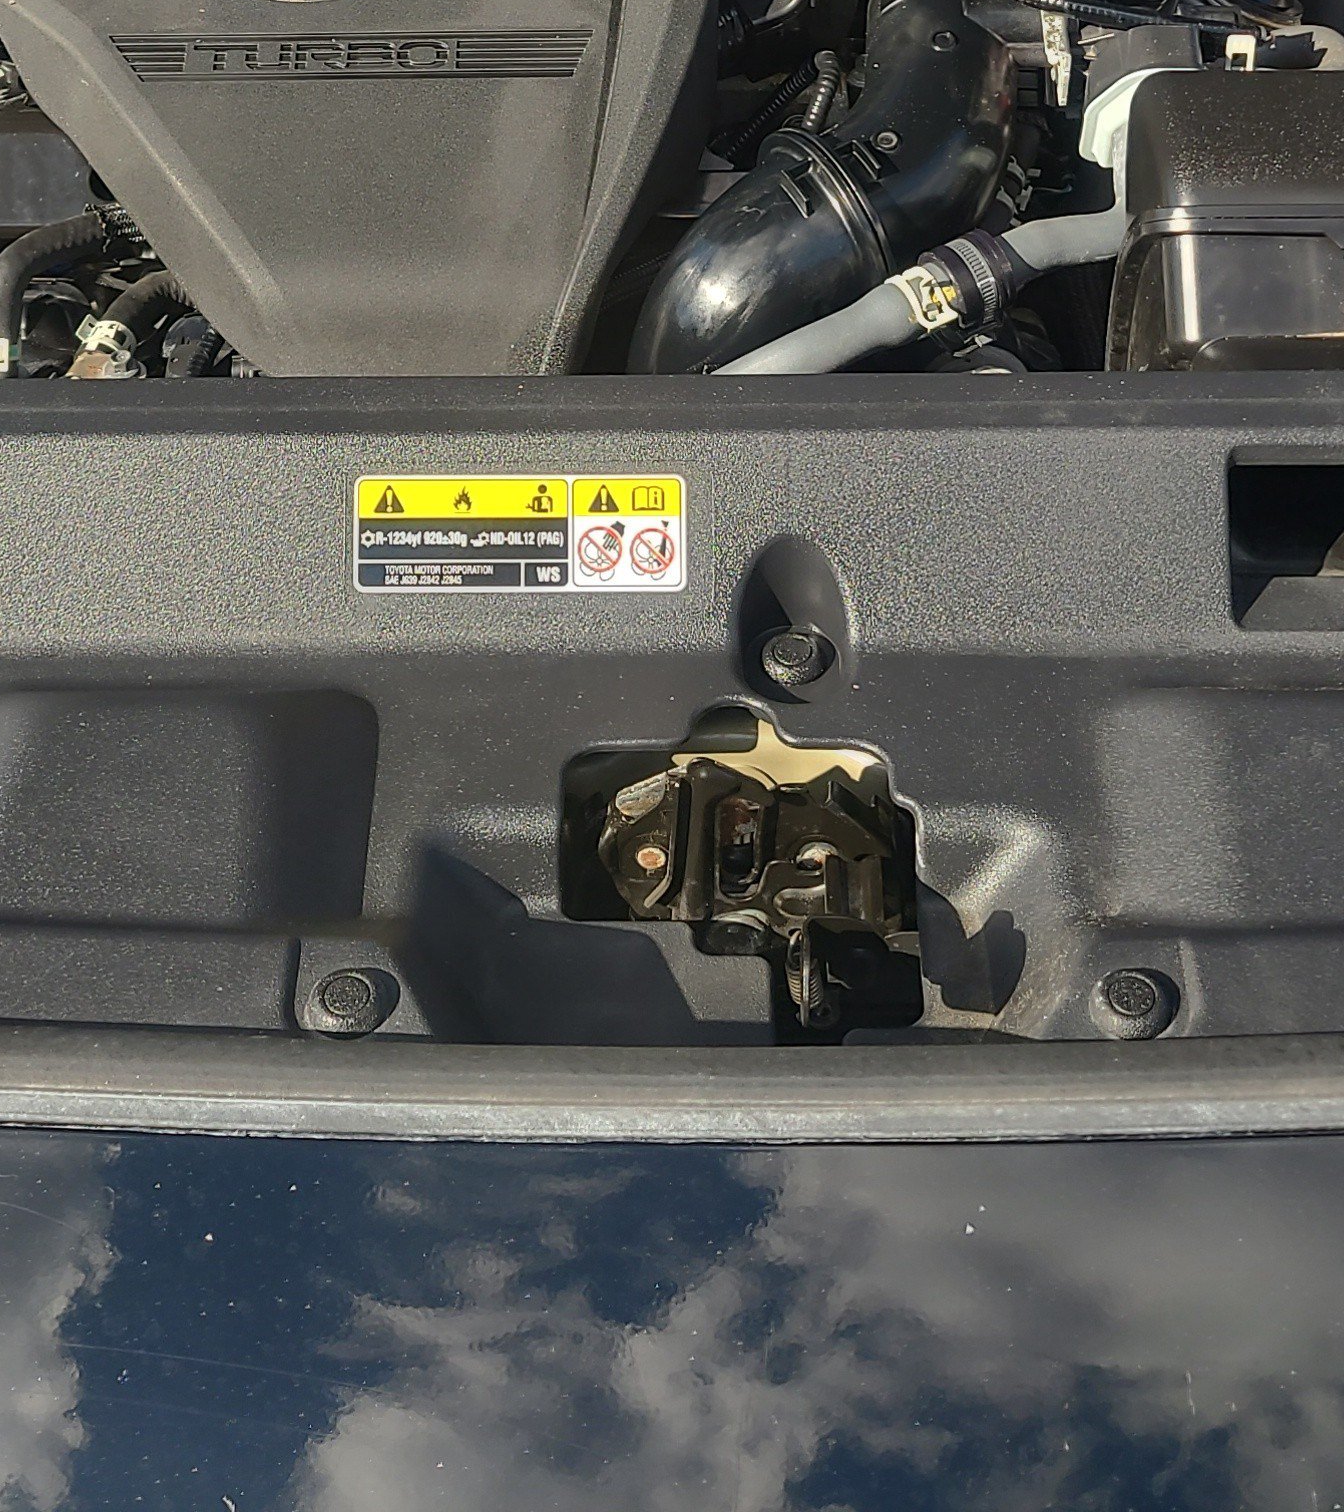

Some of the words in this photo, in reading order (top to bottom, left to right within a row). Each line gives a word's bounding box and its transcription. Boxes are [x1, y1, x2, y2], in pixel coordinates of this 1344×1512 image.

[193, 38, 451, 71] TURBO
[375, 530, 422, 548] R-1234yf
[537, 531, 564, 548] (PAG)
[385, 565, 413, 574] TOYOTA
[414, 565, 441, 574] MOTOR
[442, 565, 494, 575] CORPORATION
[536, 566, 561, 583] WS
[385, 575, 399, 585] SAE
